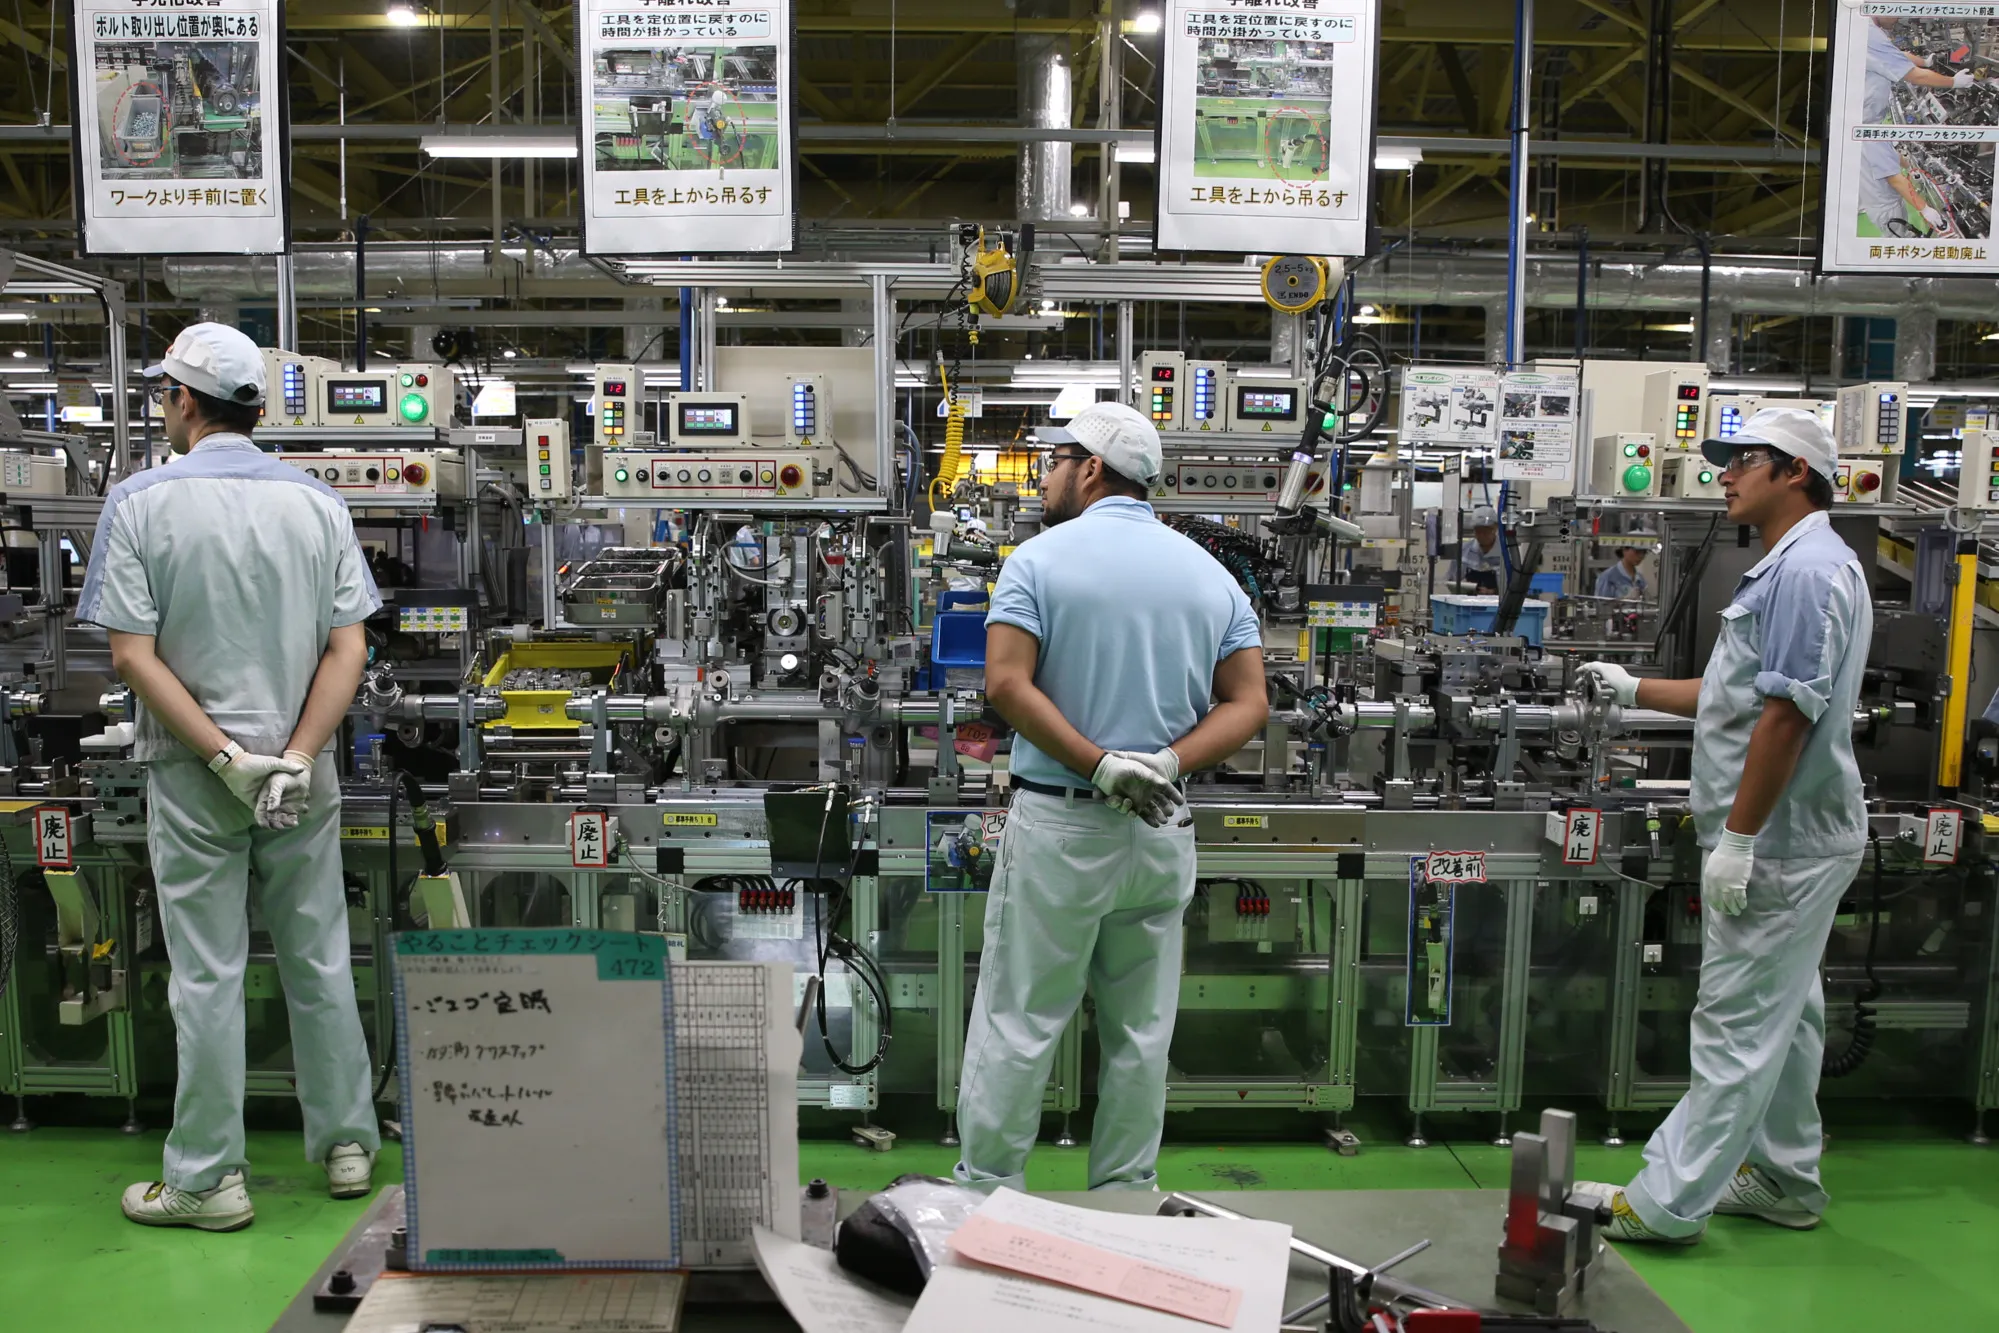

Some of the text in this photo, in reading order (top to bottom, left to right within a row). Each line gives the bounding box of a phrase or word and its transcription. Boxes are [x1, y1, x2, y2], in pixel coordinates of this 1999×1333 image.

[97, 15, 258, 37] ボルト取り出し位置が奥にある
[602, 13, 768, 25] 工具を定位置に戻すのに
[1187, 13, 1353, 28] 工具を定位置に戻すのに
[602, 26, 738, 37] 時間が掛かっている
[1187, 25, 1322, 40] 時間が掛かっている
[111, 188, 267, 206] ワークより手前に置く
[614, 187, 772, 205] 工具を上から吊るす
[1190, 186, 1349, 208] 工具を上から吊るす
[1869, 245, 1987, 260] 両手ボタン起動廃止
[1158, 369, 1171, 379] 12
[609, 384, 623, 393] 12
[1684, 388, 1697, 397] 12
[1432, 856, 1481, 878] 改善前
[610, 958, 657, 976] 472
